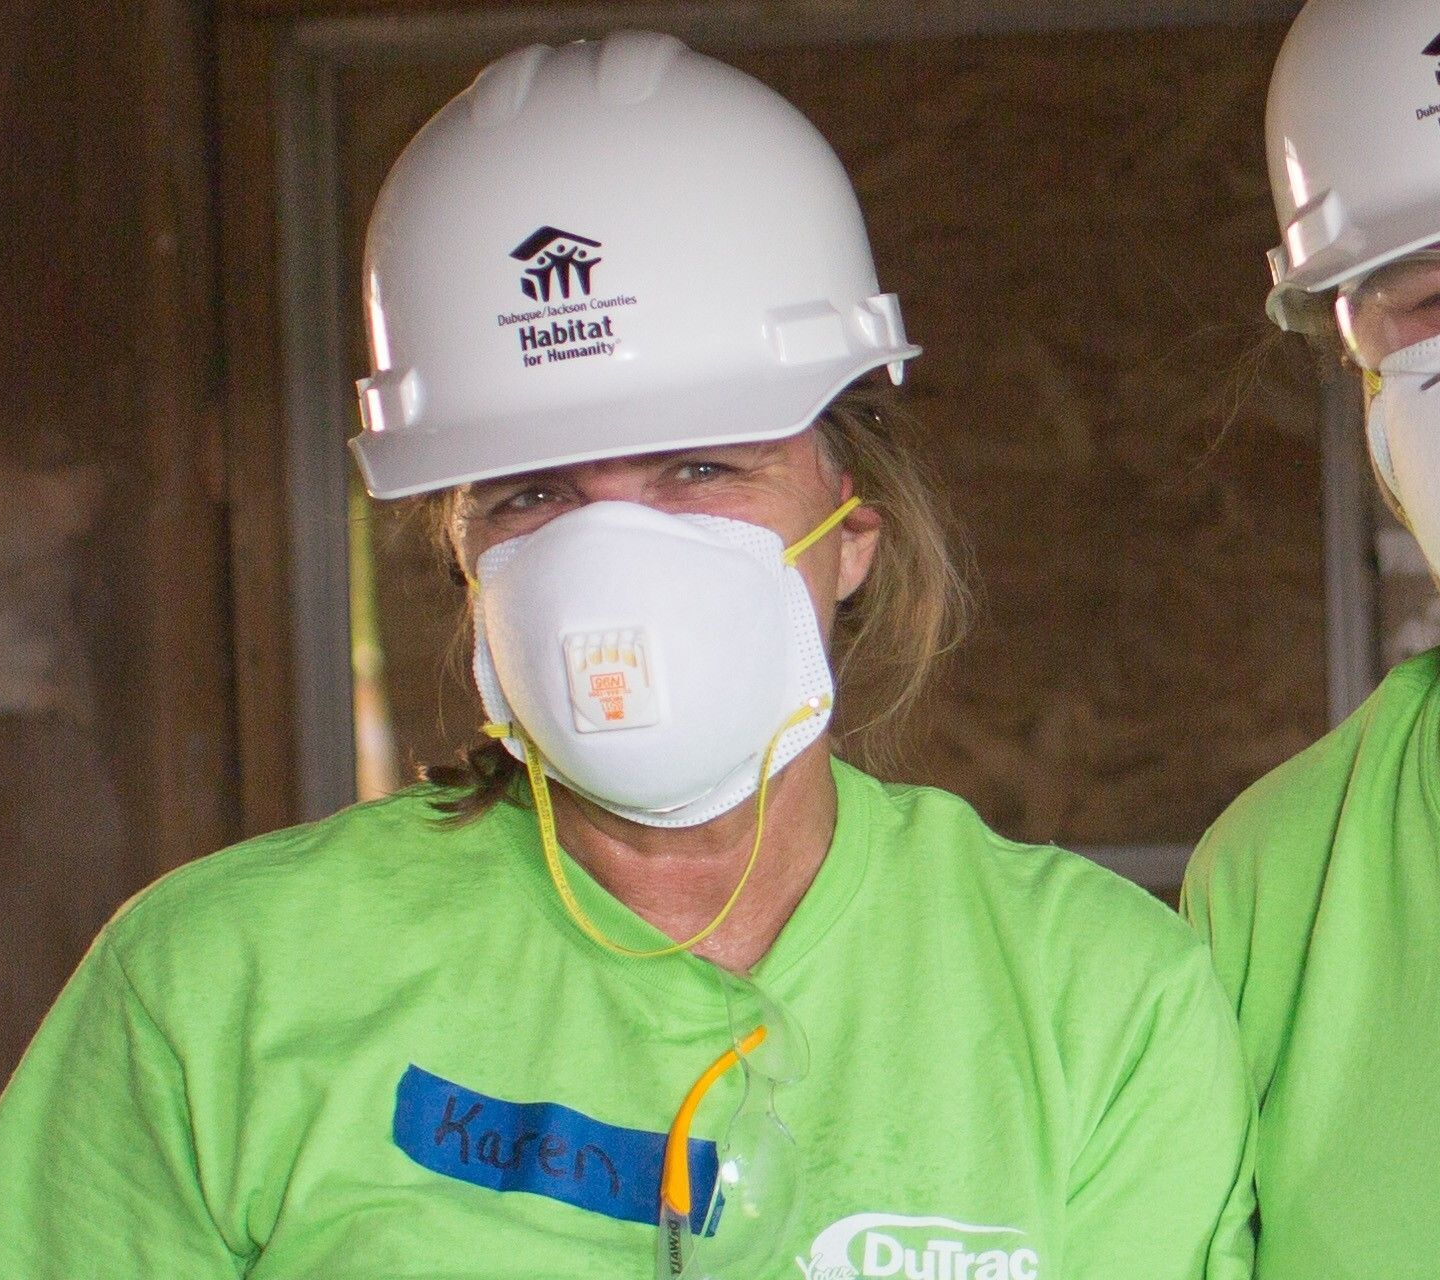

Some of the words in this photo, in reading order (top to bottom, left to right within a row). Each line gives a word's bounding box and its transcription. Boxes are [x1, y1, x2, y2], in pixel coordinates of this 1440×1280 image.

[497, 302, 588, 327] Dubuque/Jackson
[589, 294, 637, 311] Counties
[518, 316, 614, 351] Habitat
[523, 352, 543, 368] for
[547, 341, 616, 362] Humanity
[435, 1095, 621, 1198] Karen
